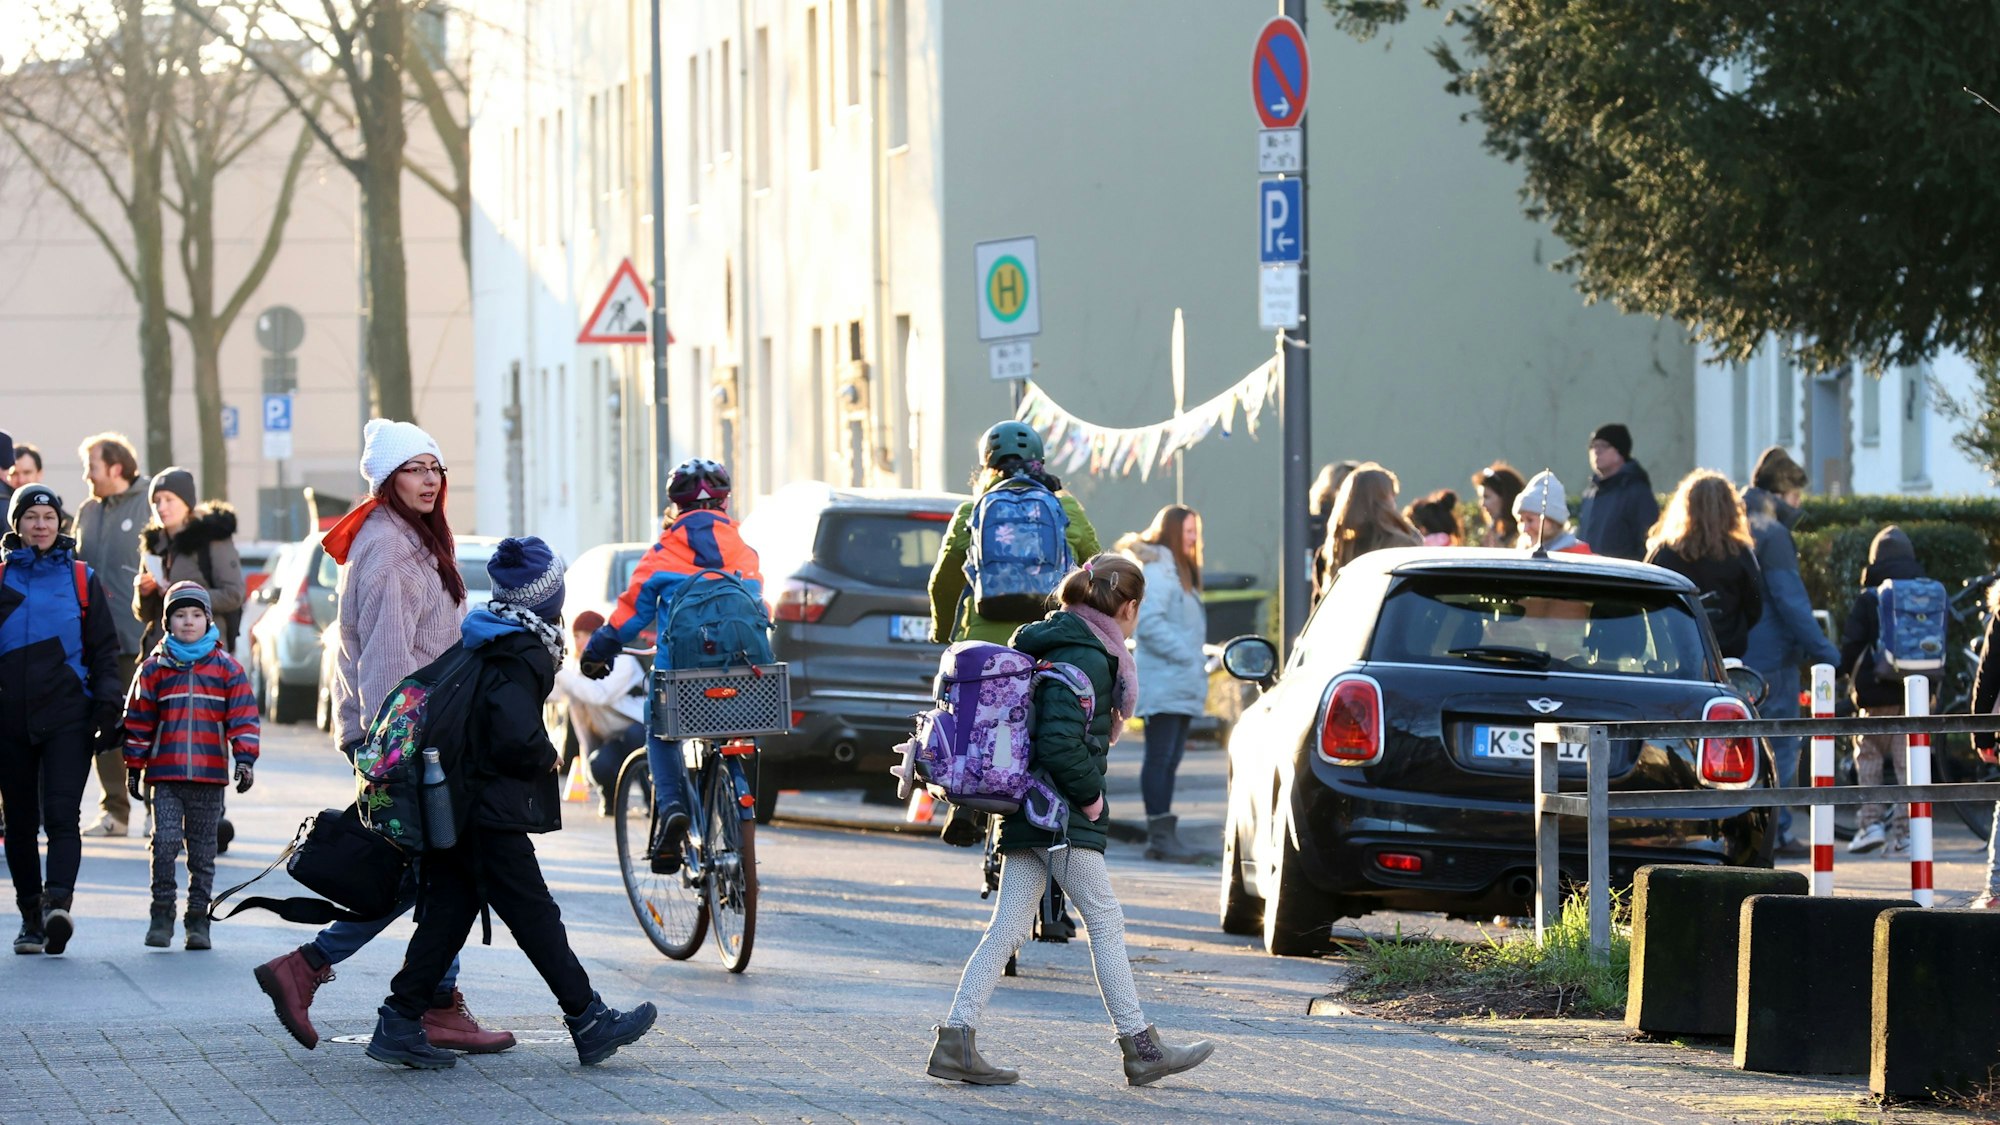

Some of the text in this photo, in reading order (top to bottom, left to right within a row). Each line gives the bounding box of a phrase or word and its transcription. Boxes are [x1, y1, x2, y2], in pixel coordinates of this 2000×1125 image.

[1265, 190, 1289, 253] P
[997, 268, 1018, 309] H
[266, 399, 285, 429] P
[902, 620, 912, 637] K
[1490, 730, 1506, 754] K
